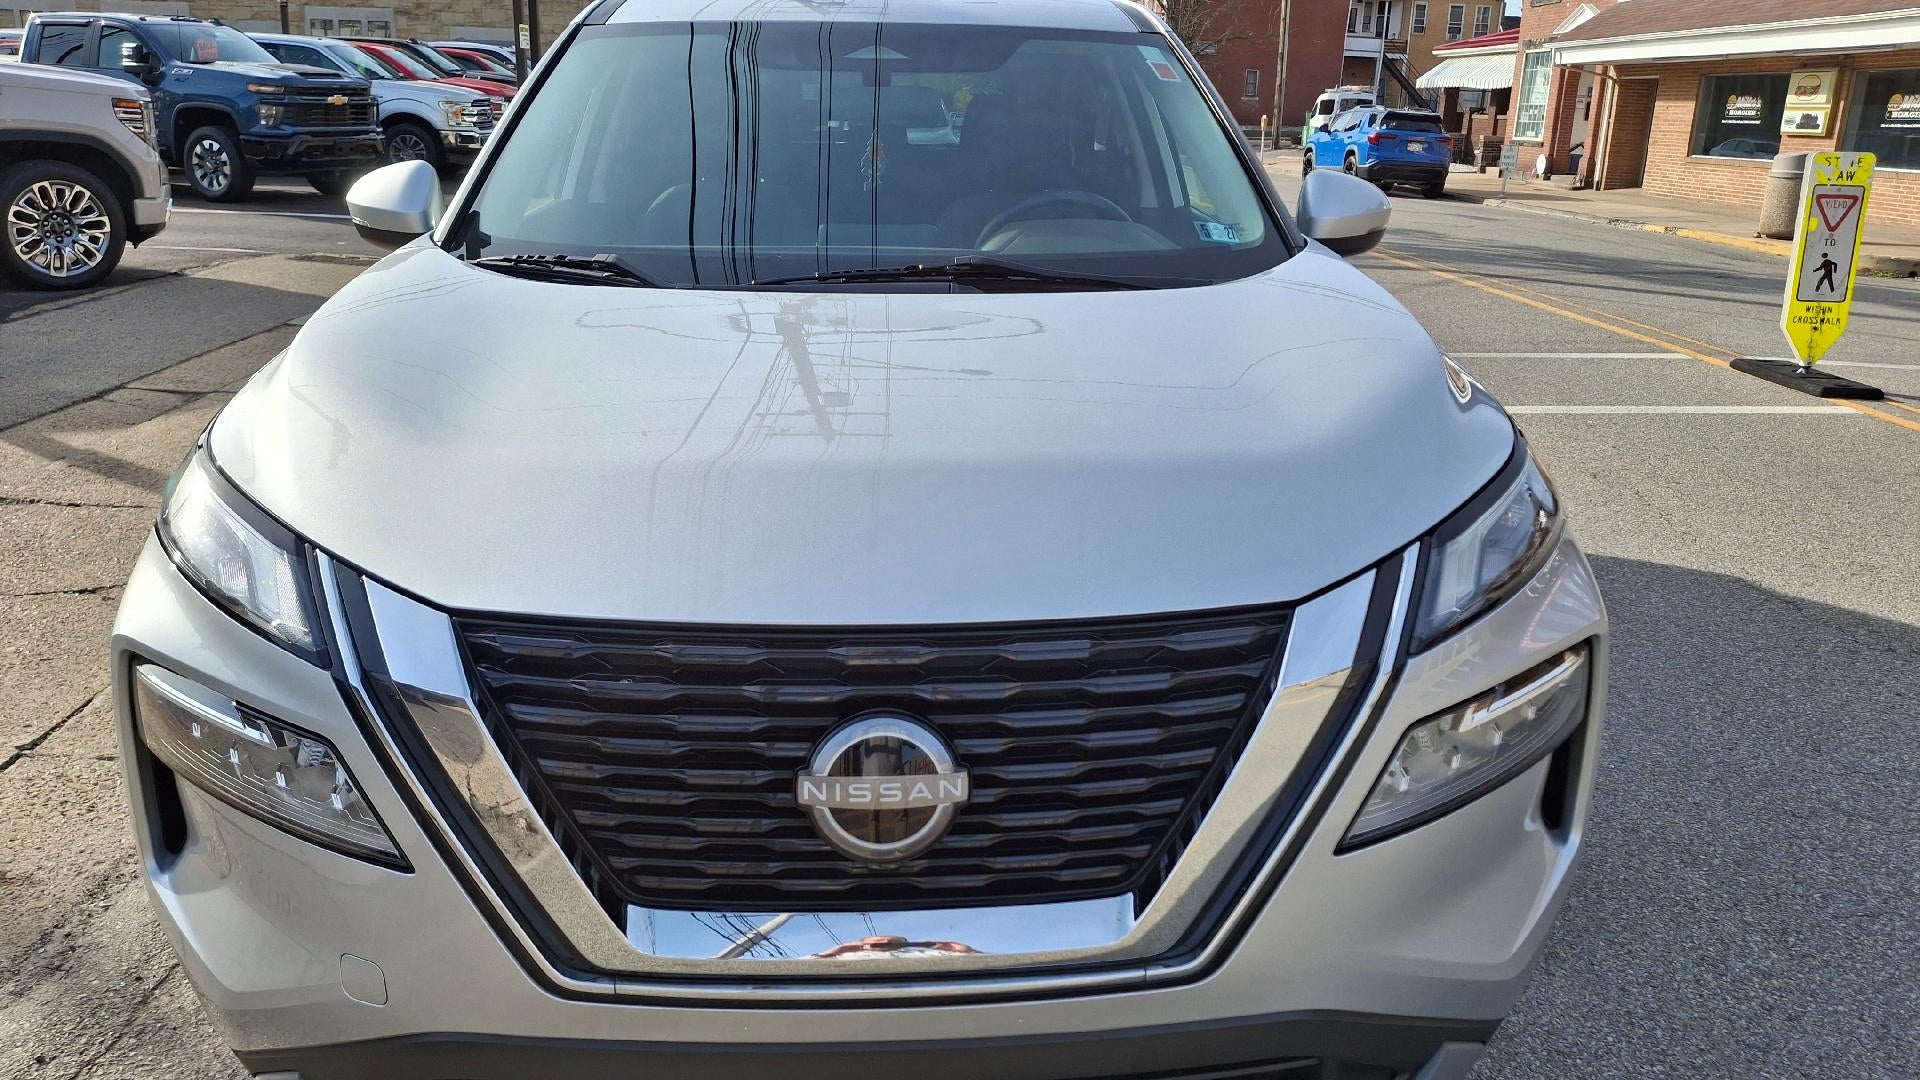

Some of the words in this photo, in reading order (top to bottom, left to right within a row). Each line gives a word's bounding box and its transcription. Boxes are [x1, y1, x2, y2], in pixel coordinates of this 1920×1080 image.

[1825, 156, 1864, 168] STE
[1827, 170, 1856, 182] AW
[1824, 238, 1836, 247] TO
[1805, 305, 1833, 315] WITHIN
[1792, 315, 1841, 325] CROSSWALK
[803, 778, 963, 803] NISSAN
